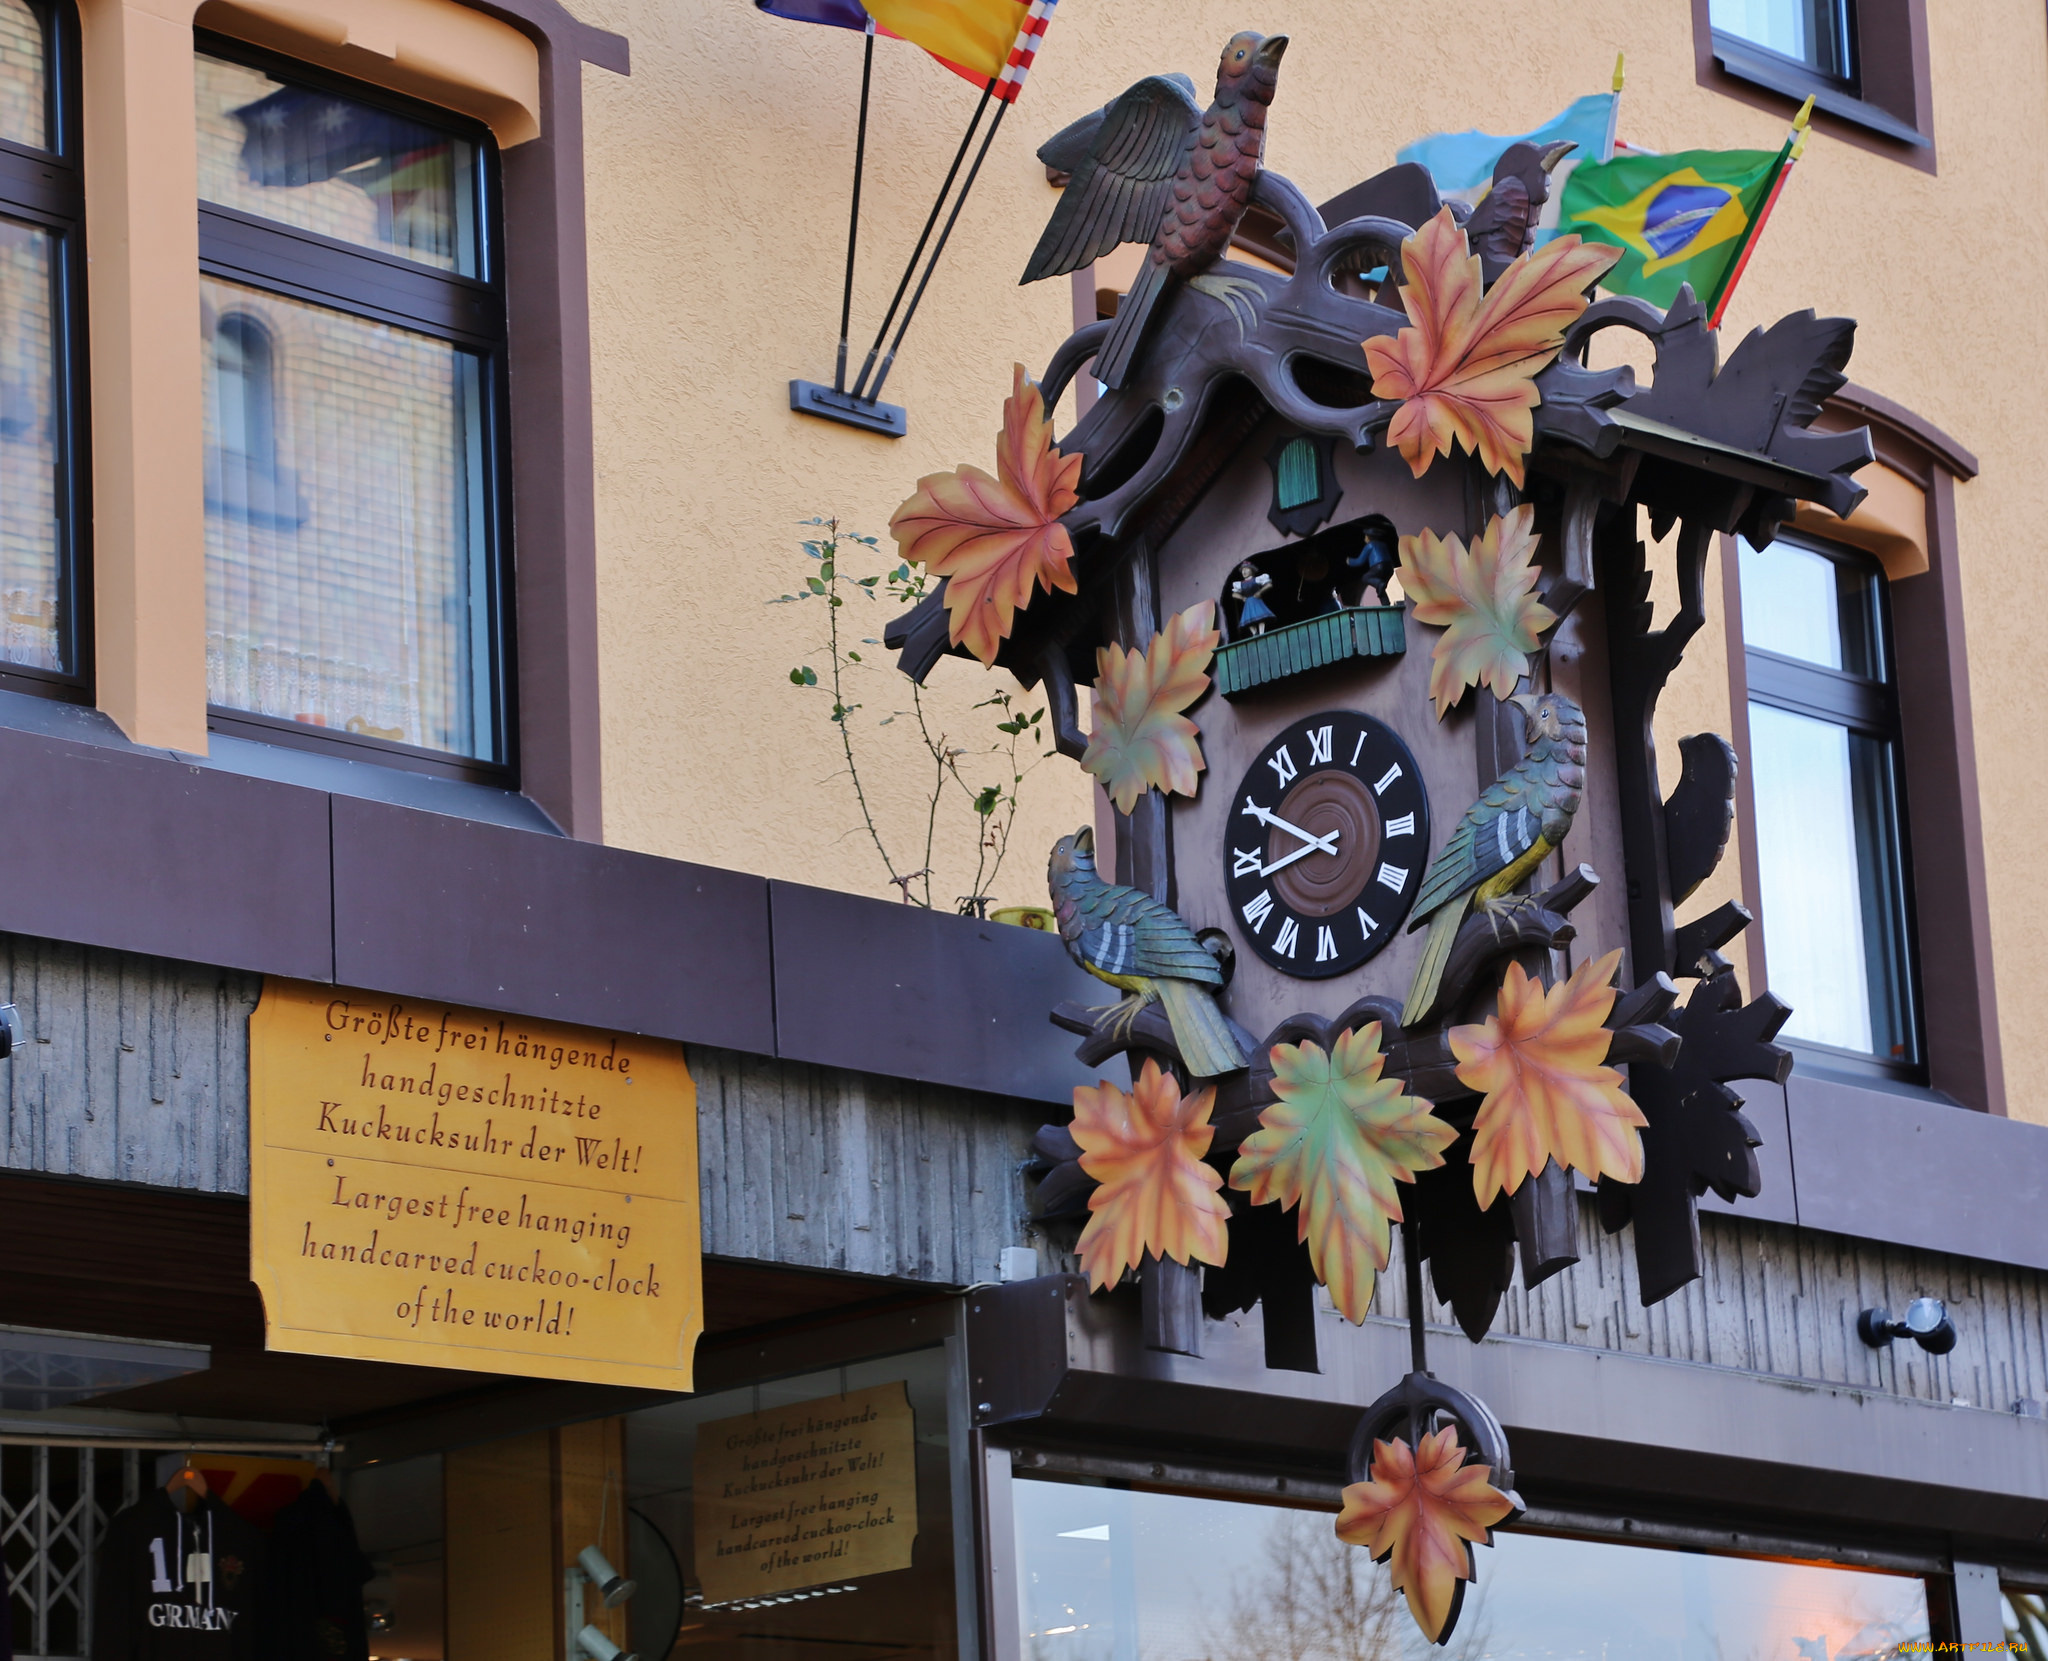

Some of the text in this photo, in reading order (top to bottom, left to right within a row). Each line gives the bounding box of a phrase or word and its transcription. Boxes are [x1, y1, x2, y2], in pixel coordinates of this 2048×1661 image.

[1267, 744, 1298, 789] XI
[1306, 725, 1333, 766] XII
[1350, 730, 1367, 767] I
[1374, 762, 1402, 796] II
[1386, 811, 1415, 839] III
[1242, 889, 1274, 934] VIII
[1357, 906, 1379, 940] V
[1272, 916, 1299, 959] VII
[1315, 925, 1339, 962] VI
[325, 999, 430, 1045] Größte
[361, 1053, 601, 1121] handgeschnitzte
[315, 1101, 643, 1174] Kuckucksuhr der Welt!
[331, 1175, 631, 1248] Largest free hanging
[301, 1221, 661, 1298] handcarved cuckoo-clock
[397, 1285, 575, 1336] of the world!
[722, 1452, 885, 1499] Kuckucksuhr der Welt!
